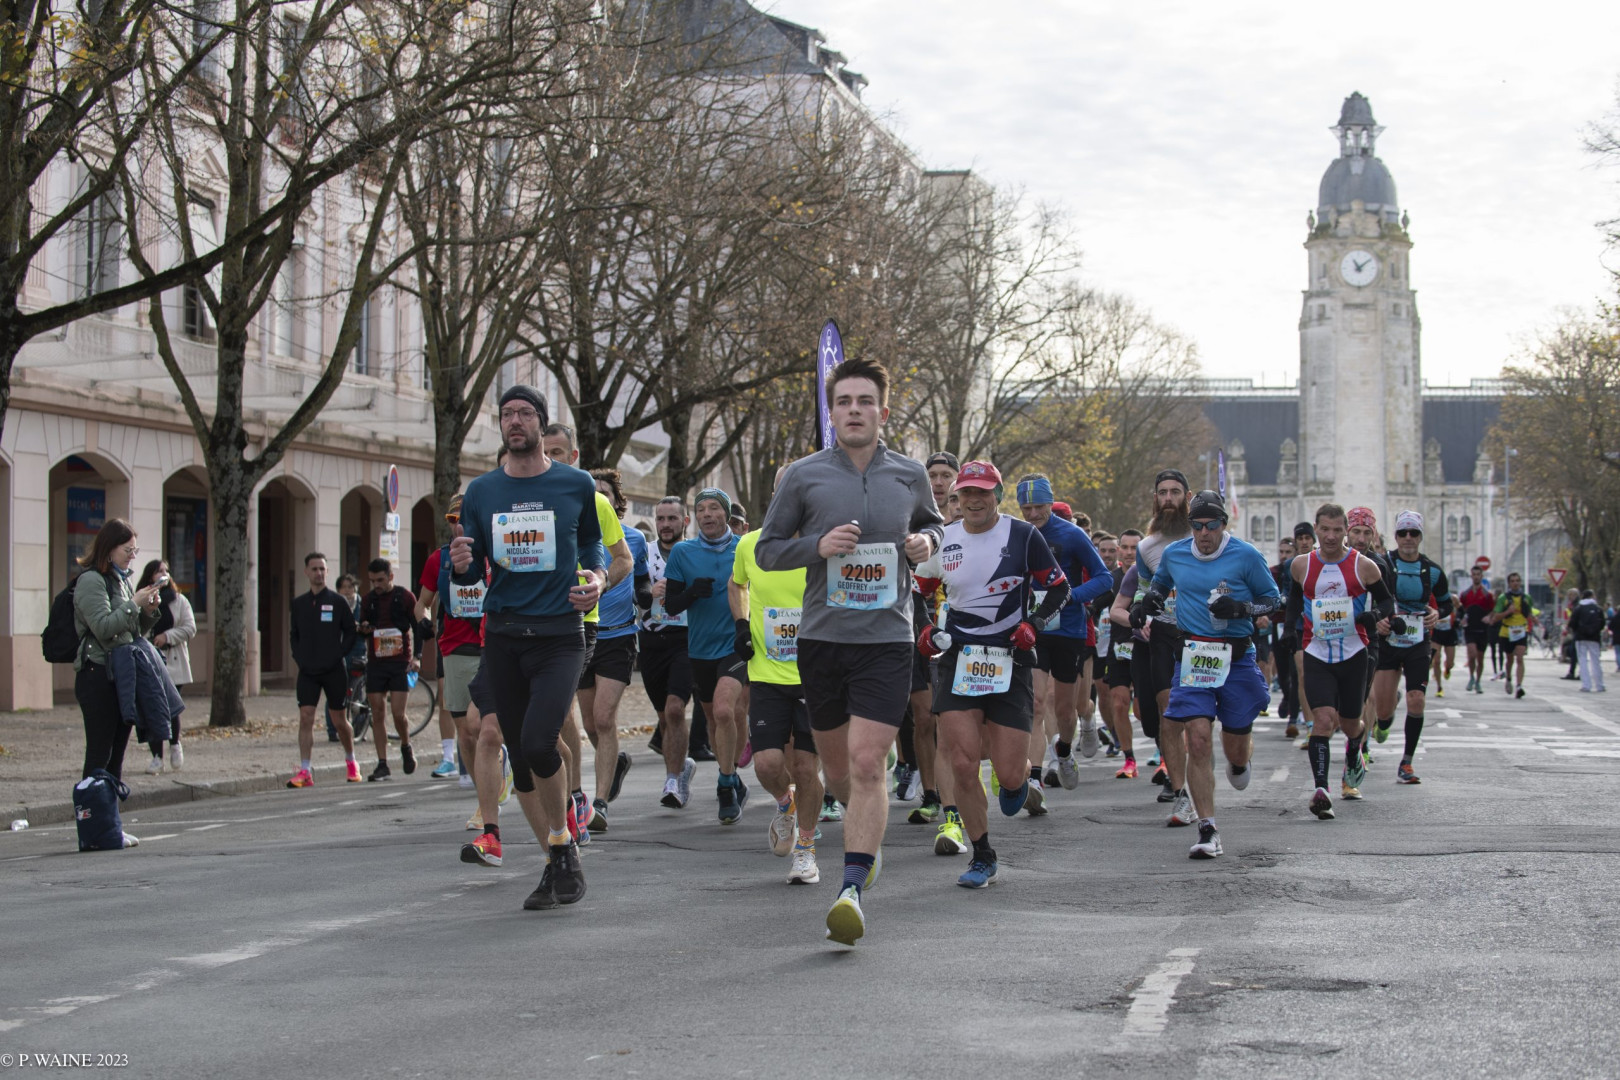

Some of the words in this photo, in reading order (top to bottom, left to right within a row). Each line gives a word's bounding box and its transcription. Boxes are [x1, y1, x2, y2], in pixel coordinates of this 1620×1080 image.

[522, 514, 550, 522] NATURE
[510, 530, 537, 546] 1147
[942, 552, 963, 562] TUB
[845, 564, 882, 582] 2205
[838, 580, 868, 591] GEOFFREY
[460, 588, 480, 600] 1546
[1325, 610, 1341, 622] 834
[1194, 655, 1220, 669] 2782
[972, 661, 996, 678] 609
